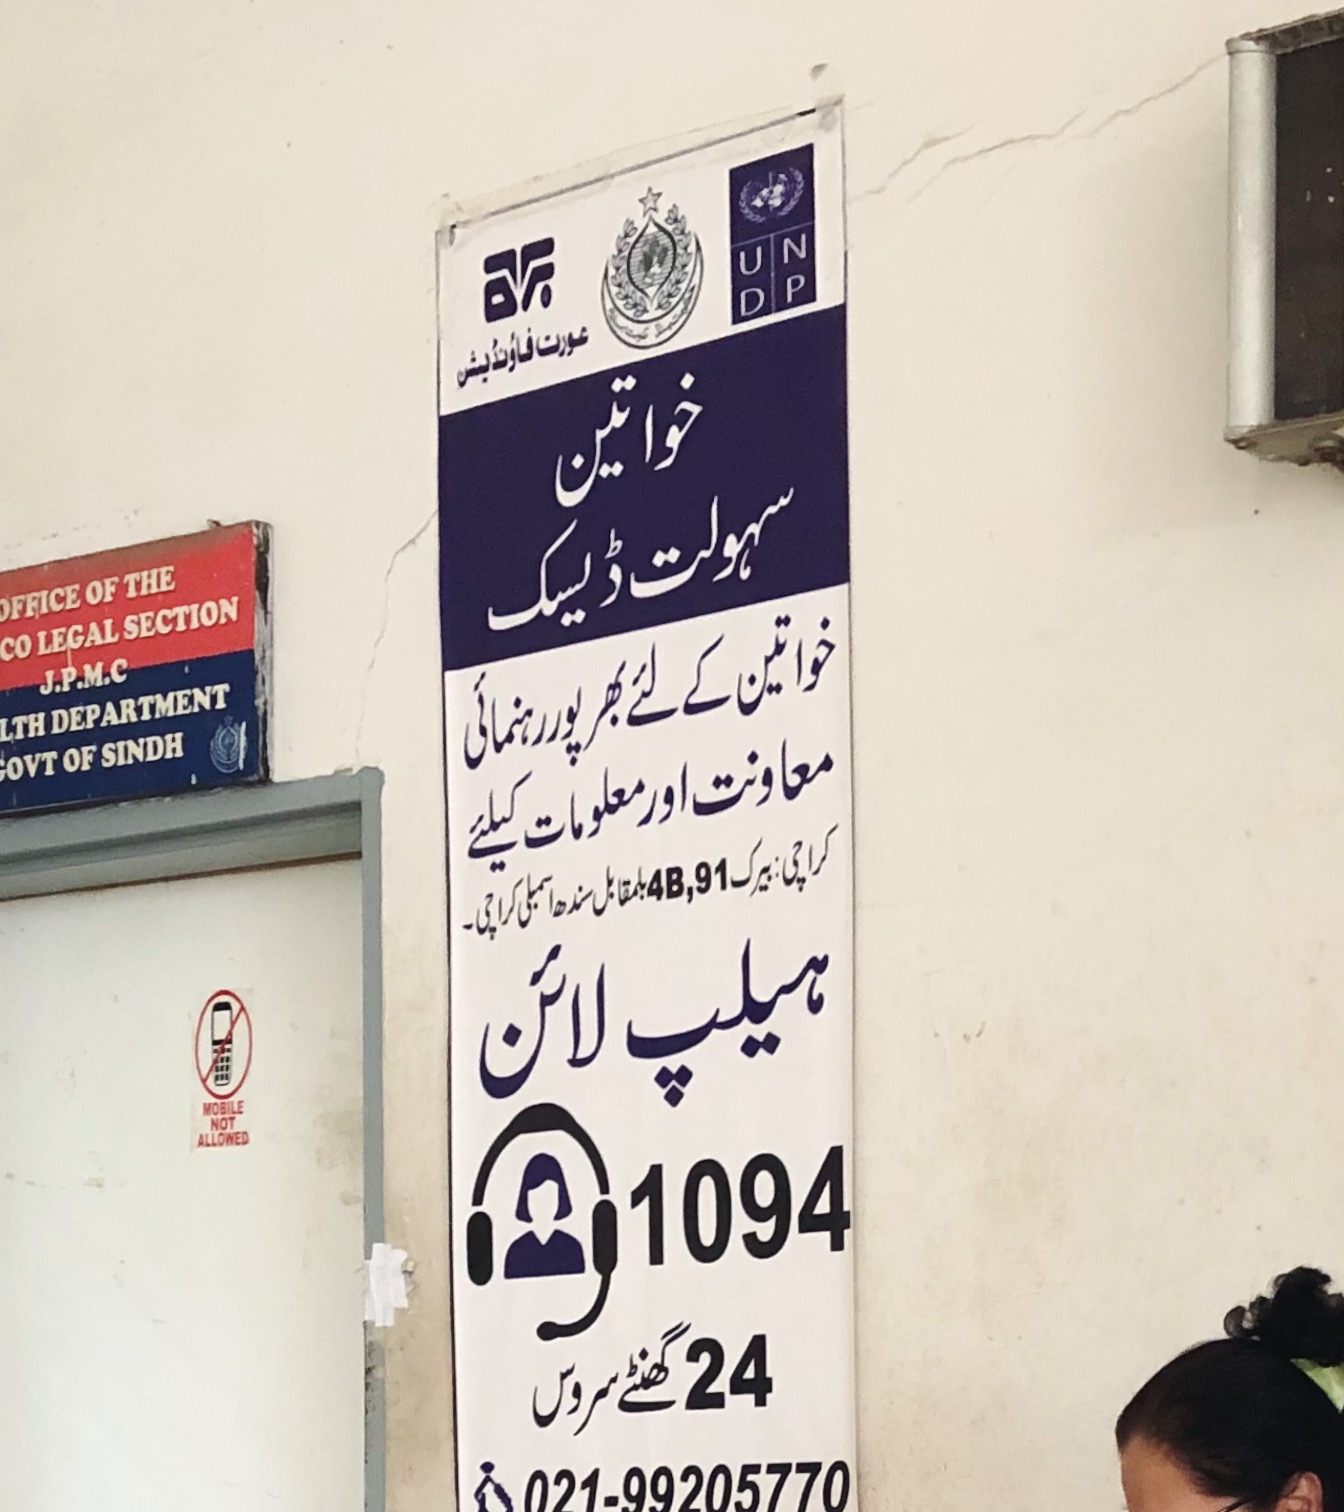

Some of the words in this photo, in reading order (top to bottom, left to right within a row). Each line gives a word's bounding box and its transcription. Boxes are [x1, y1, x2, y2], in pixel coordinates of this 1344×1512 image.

[457, 328, 533, 388] فاؤنڈیشن
[537, 326, 589, 357] عورت
[556, 373, 704, 507] خواتین
[488, 518, 621, 632] ڈیسک
[629, 487, 795, 600] سہولت
[85, 577, 117, 607] OF
[124, 565, 175, 597] THE
[38, 618, 118, 656] LEGAL
[124, 596, 240, 638] SECTION
[737, 614, 836, 717] خواتین
[40, 659, 128, 696] J.P.M.C
[51, 683, 230, 735] DEPARTMENT
[626, 642, 679, 727] لئے
[683, 633, 732, 715] کے
[63, 744, 96, 773] OF
[101, 732, 184, 768] SINDH
[463, 671, 547, 770] رہنمائی
[524, 767, 645, 850] معلومات
[636, 761, 688, 828] اور
[692, 737, 834, 817] معاونت
[467, 770, 533, 873] کیلئے
[552, 884, 594, 918] سندھ
[479, 943, 606, 1100] لائن
[626, 937, 829, 1108] ہیلپ
[197, 1131, 250, 1148] ALLOWED
[202, 1100, 244, 1117] MOBILE
[210, 1116, 236, 1131] NOT
[630, 1145, 851, 1266] 1094
[532, 1362, 619, 1437] سروس
[617, 1321, 692, 1414] گھنٹے
[684, 1333, 773, 1411] 24
